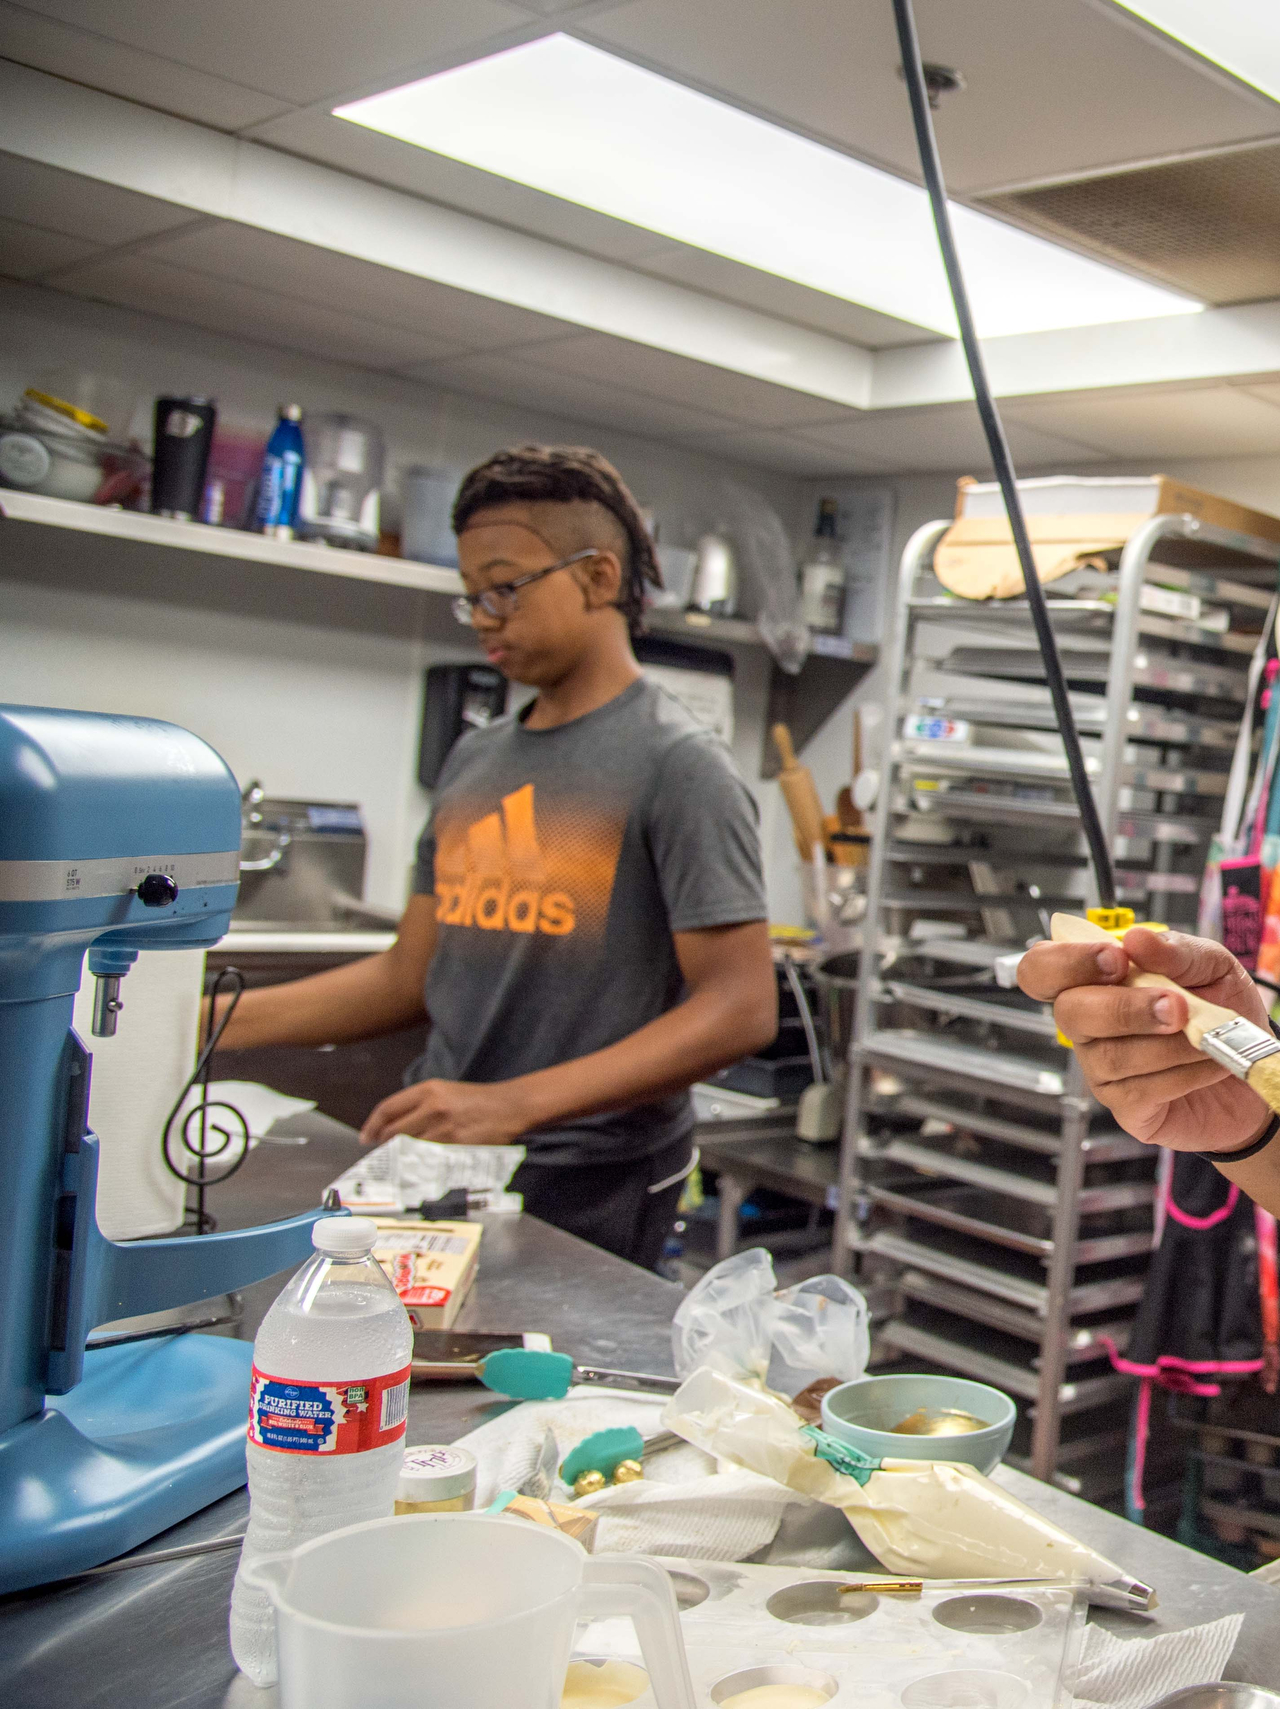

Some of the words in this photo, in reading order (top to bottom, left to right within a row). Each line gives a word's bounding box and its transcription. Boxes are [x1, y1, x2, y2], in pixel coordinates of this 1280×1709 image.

[259, 1402, 296, 1416] DRINKING
[298, 1410, 332, 1418] WATER
[264, 1395, 323, 1411] PURIFIED
